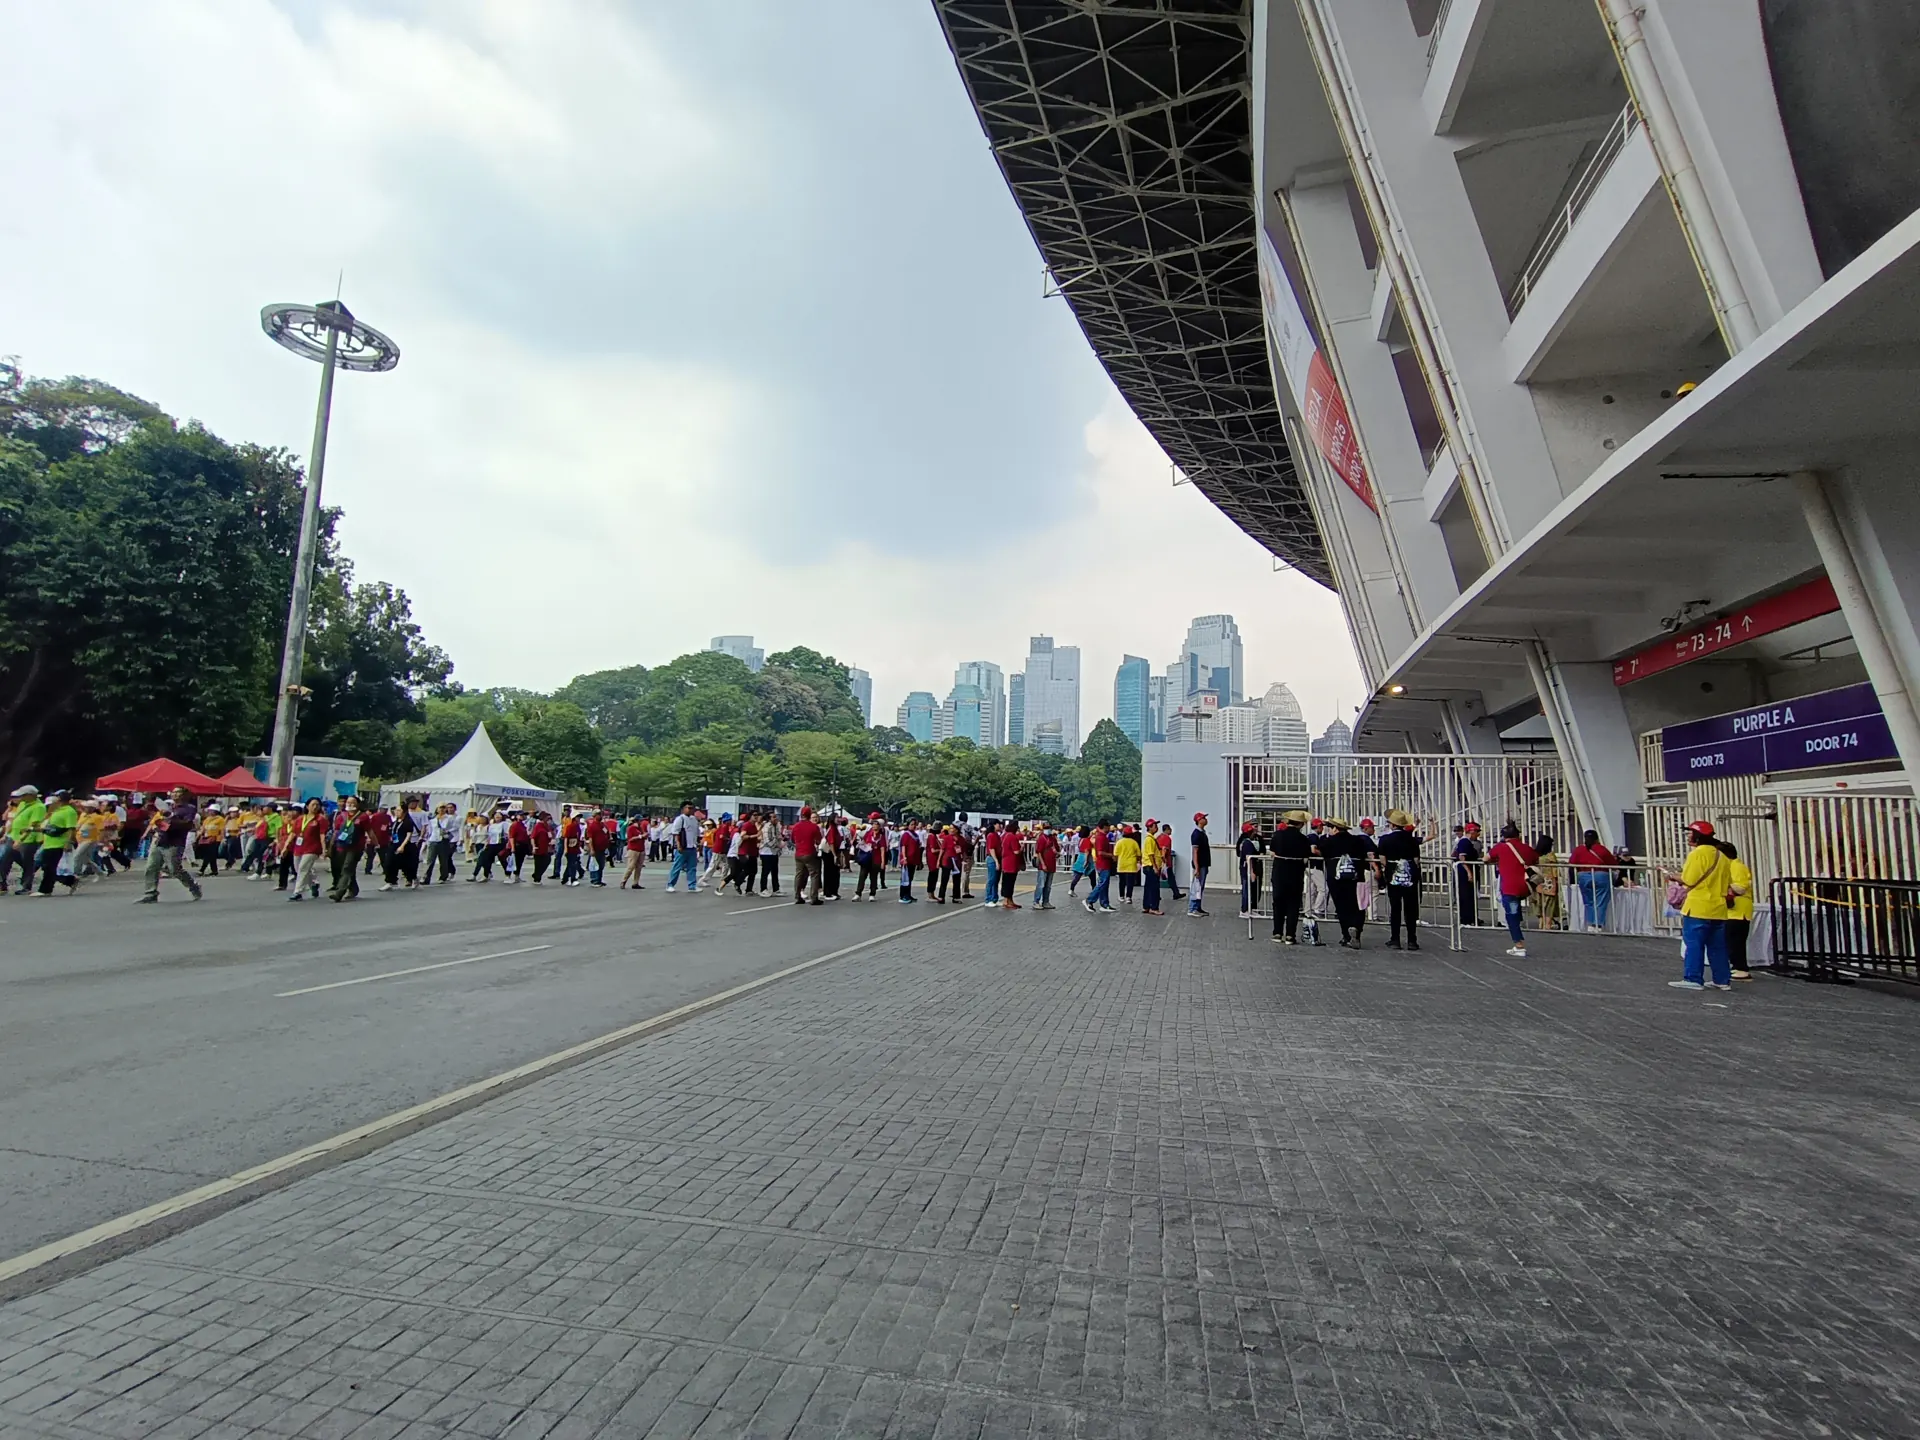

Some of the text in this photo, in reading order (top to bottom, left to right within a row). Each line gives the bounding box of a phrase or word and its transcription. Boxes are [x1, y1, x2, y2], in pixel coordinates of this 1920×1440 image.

[1335, 419, 1347, 441] 25
[1691, 632, 1705, 652] 73
[1715, 622, 1732, 643] 74
[1733, 706, 1796, 734] PURPLE A
[1805, 732, 1858, 753] DOOR 74
[1691, 752, 1724, 769] DOOR 73
[502, 787, 525, 796] POSKO
